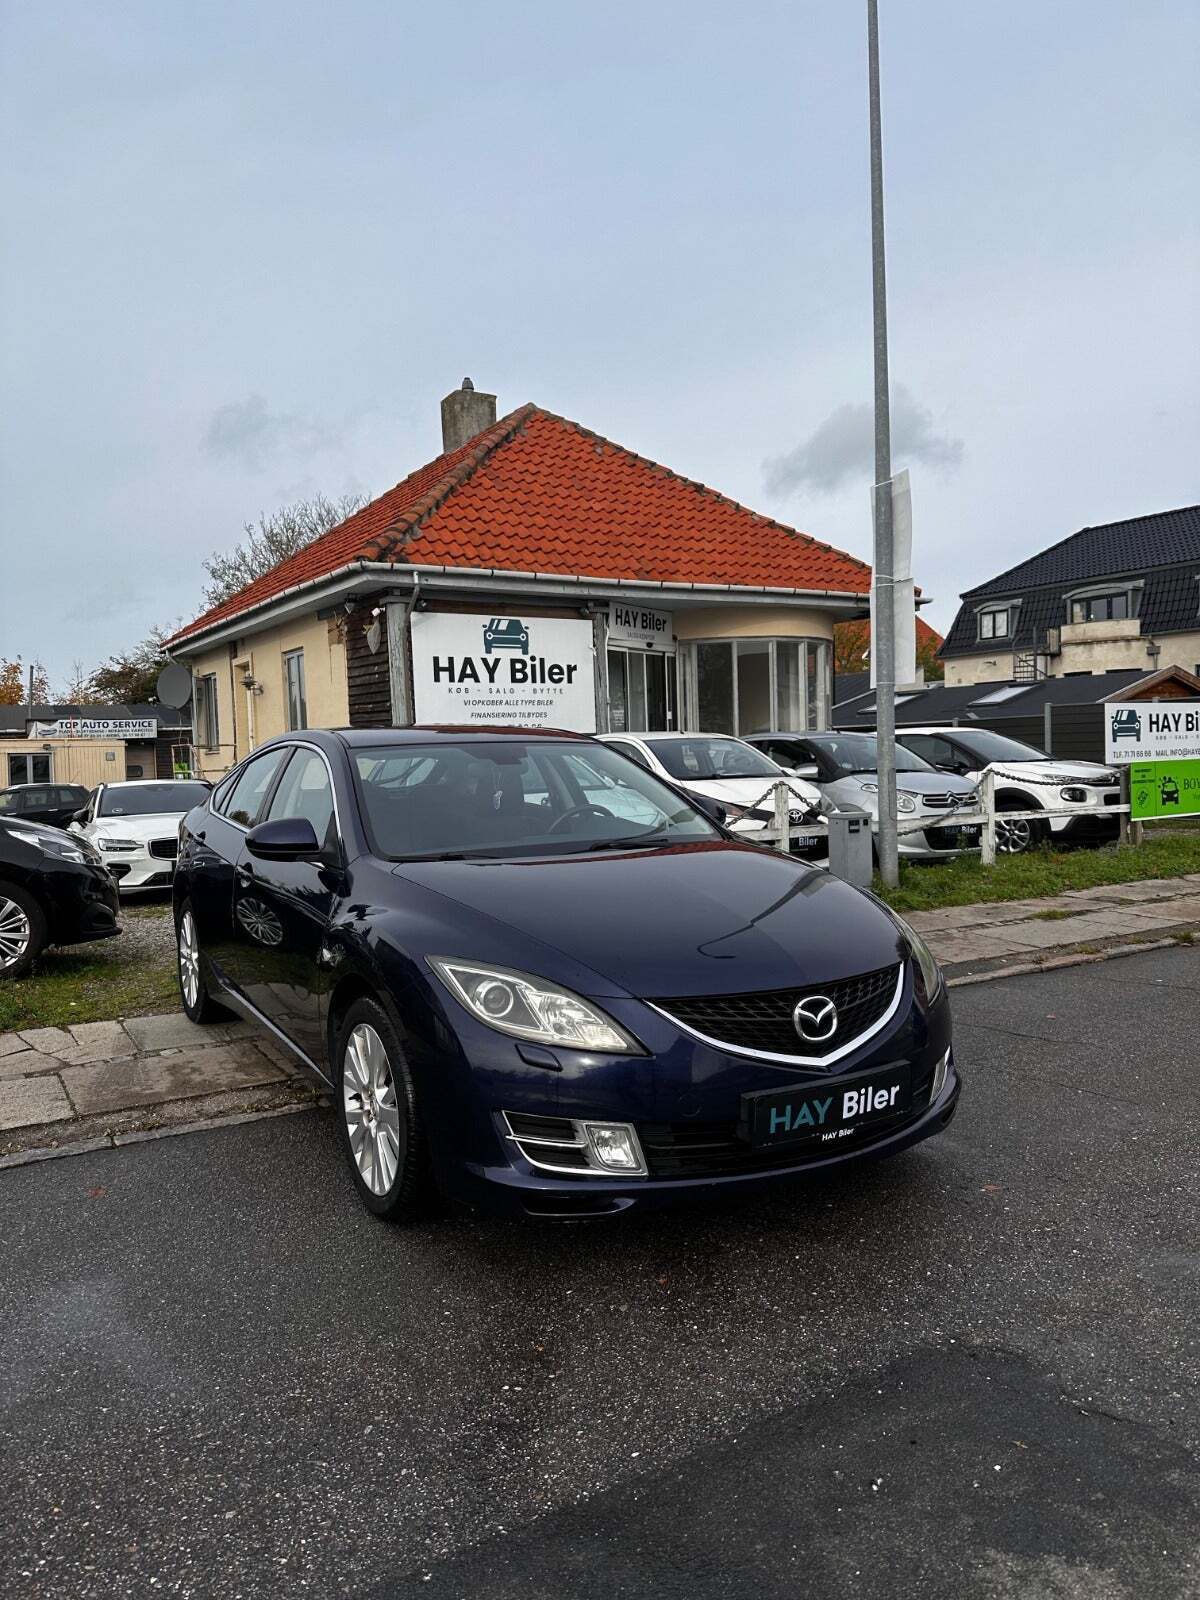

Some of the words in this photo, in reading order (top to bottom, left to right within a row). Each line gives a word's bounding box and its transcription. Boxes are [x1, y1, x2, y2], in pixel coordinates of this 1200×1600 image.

[615, 608, 639, 628] HAY
[641, 611, 667, 632] Biler
[432, 656, 501, 684] HAY
[510, 655, 577, 684] Biler
[470, 711, 517, 719] FINANSIERING
[518, 711, 548, 719] TILBYDES
[1148, 712, 1182, 733] HAY
[1185, 711, 1200, 732] Bi
[59, 721, 79, 729] TOP
[82, 721, 109, 729] AUTO
[112, 720, 153, 729] SERVICE
[799, 836, 818, 846] Biler
[769, 1097, 834, 1134] HAY
[842, 1084, 900, 1119] Biler
[821, 1131, 838, 1142] HAY
[838, 1127, 855, 1138] Biler
